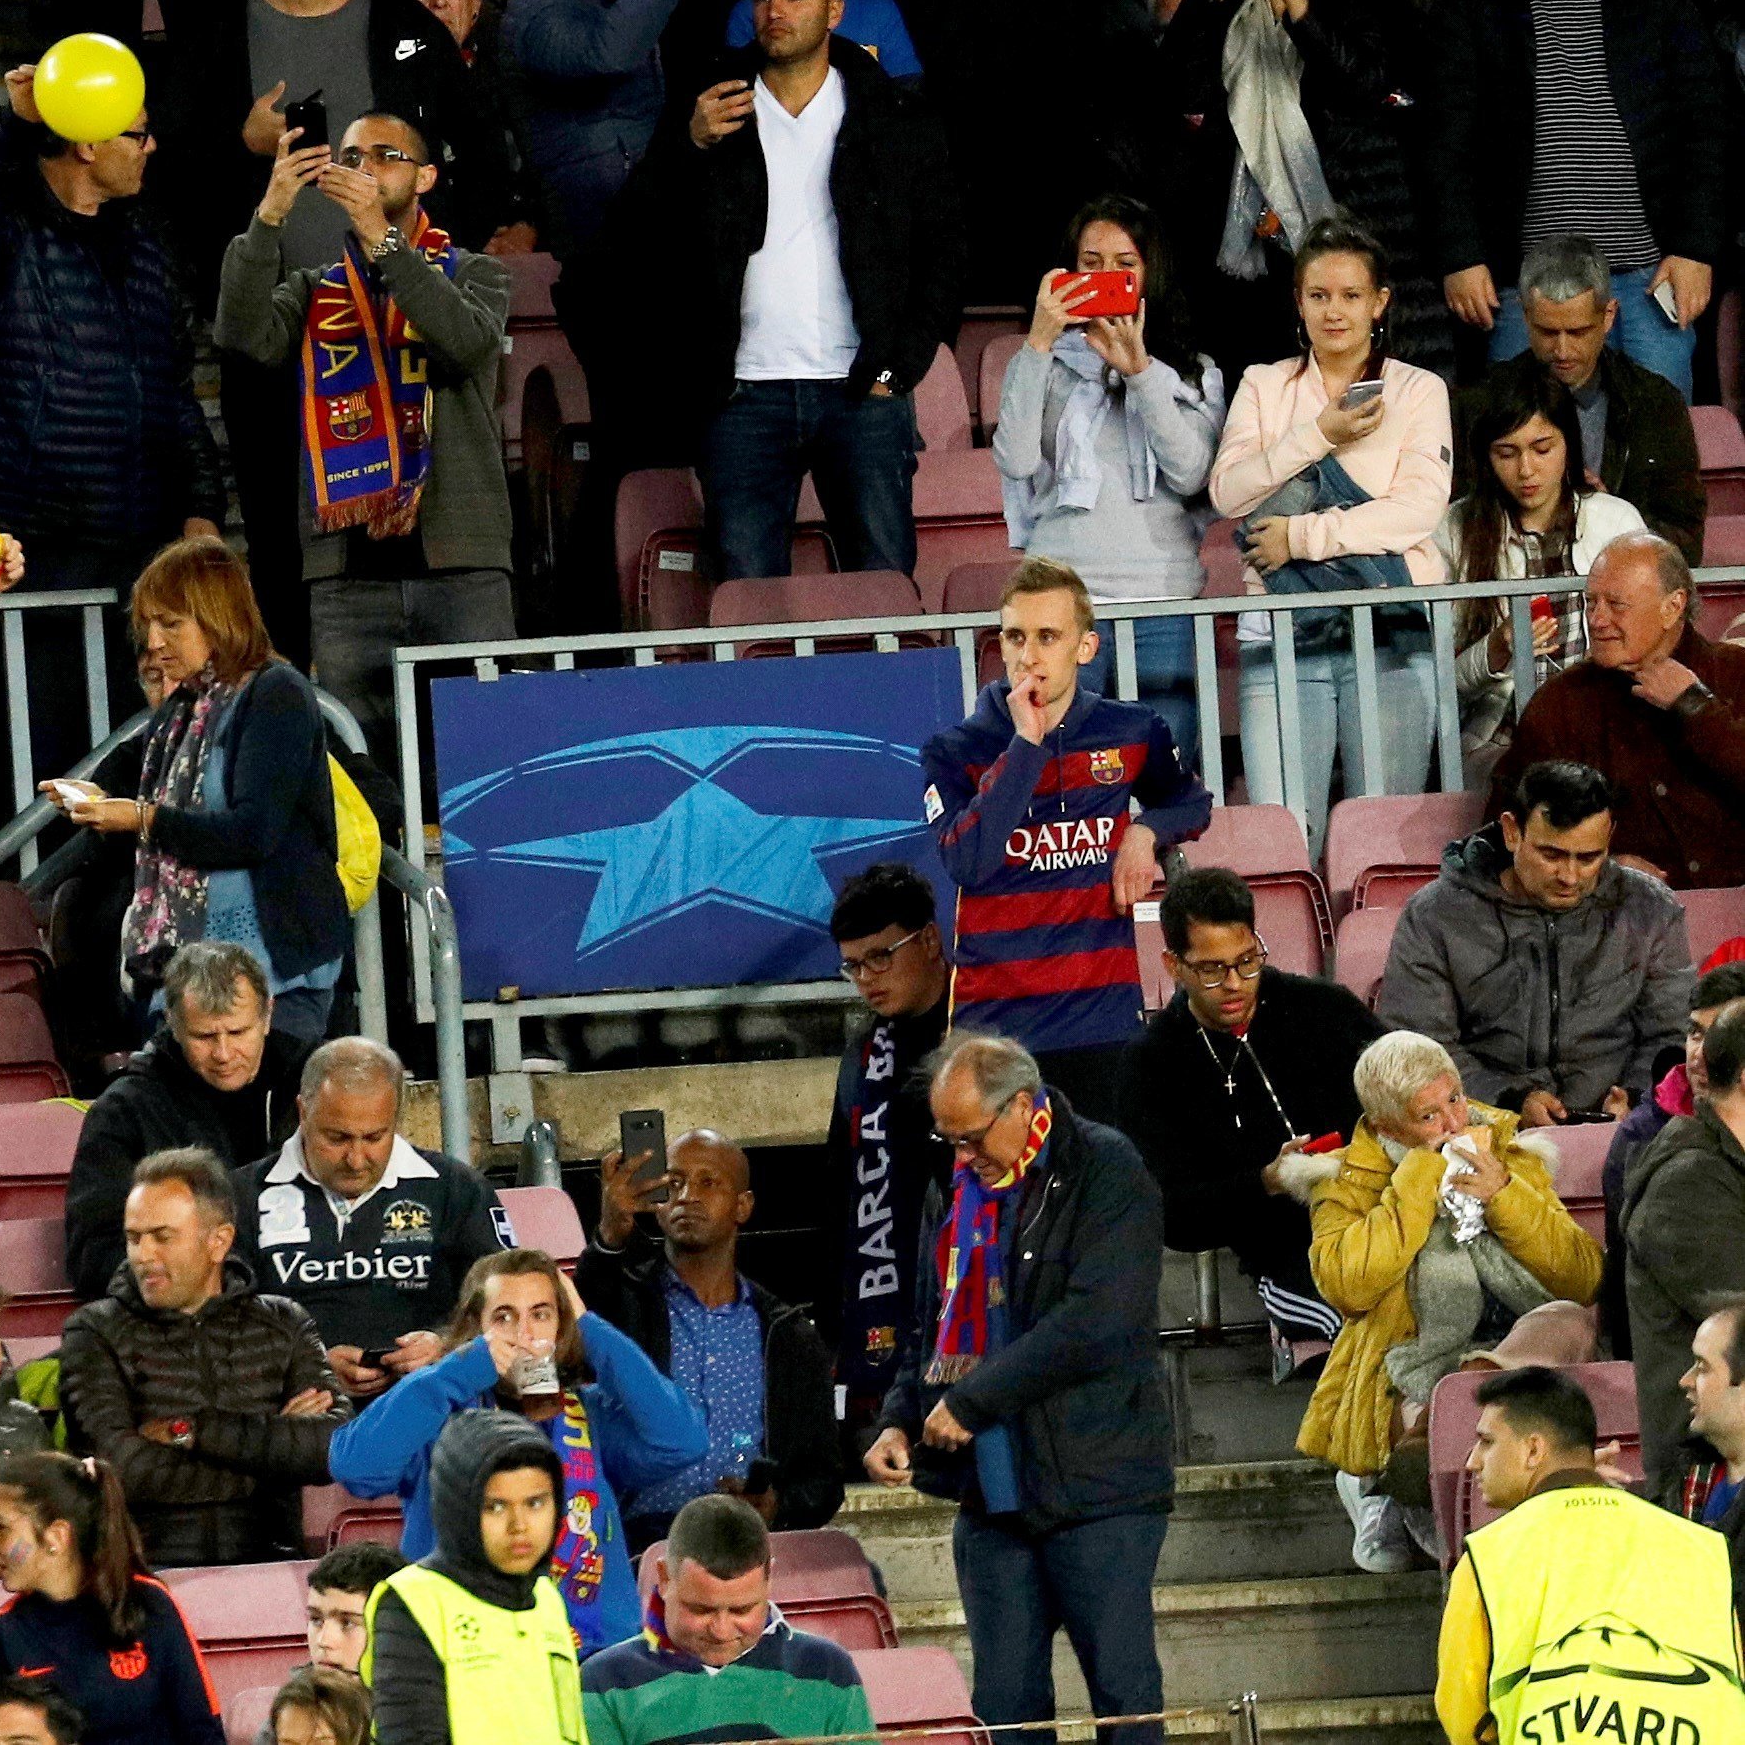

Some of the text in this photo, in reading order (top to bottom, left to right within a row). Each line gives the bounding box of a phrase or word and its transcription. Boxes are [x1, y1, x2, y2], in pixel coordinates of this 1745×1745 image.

[327, 460, 391, 483] SINCE 1899
[1005, 817, 1115, 858] QATAR
[1029, 846, 1109, 873] AIRWAYS
[271, 1248, 431, 1284] Verbier
